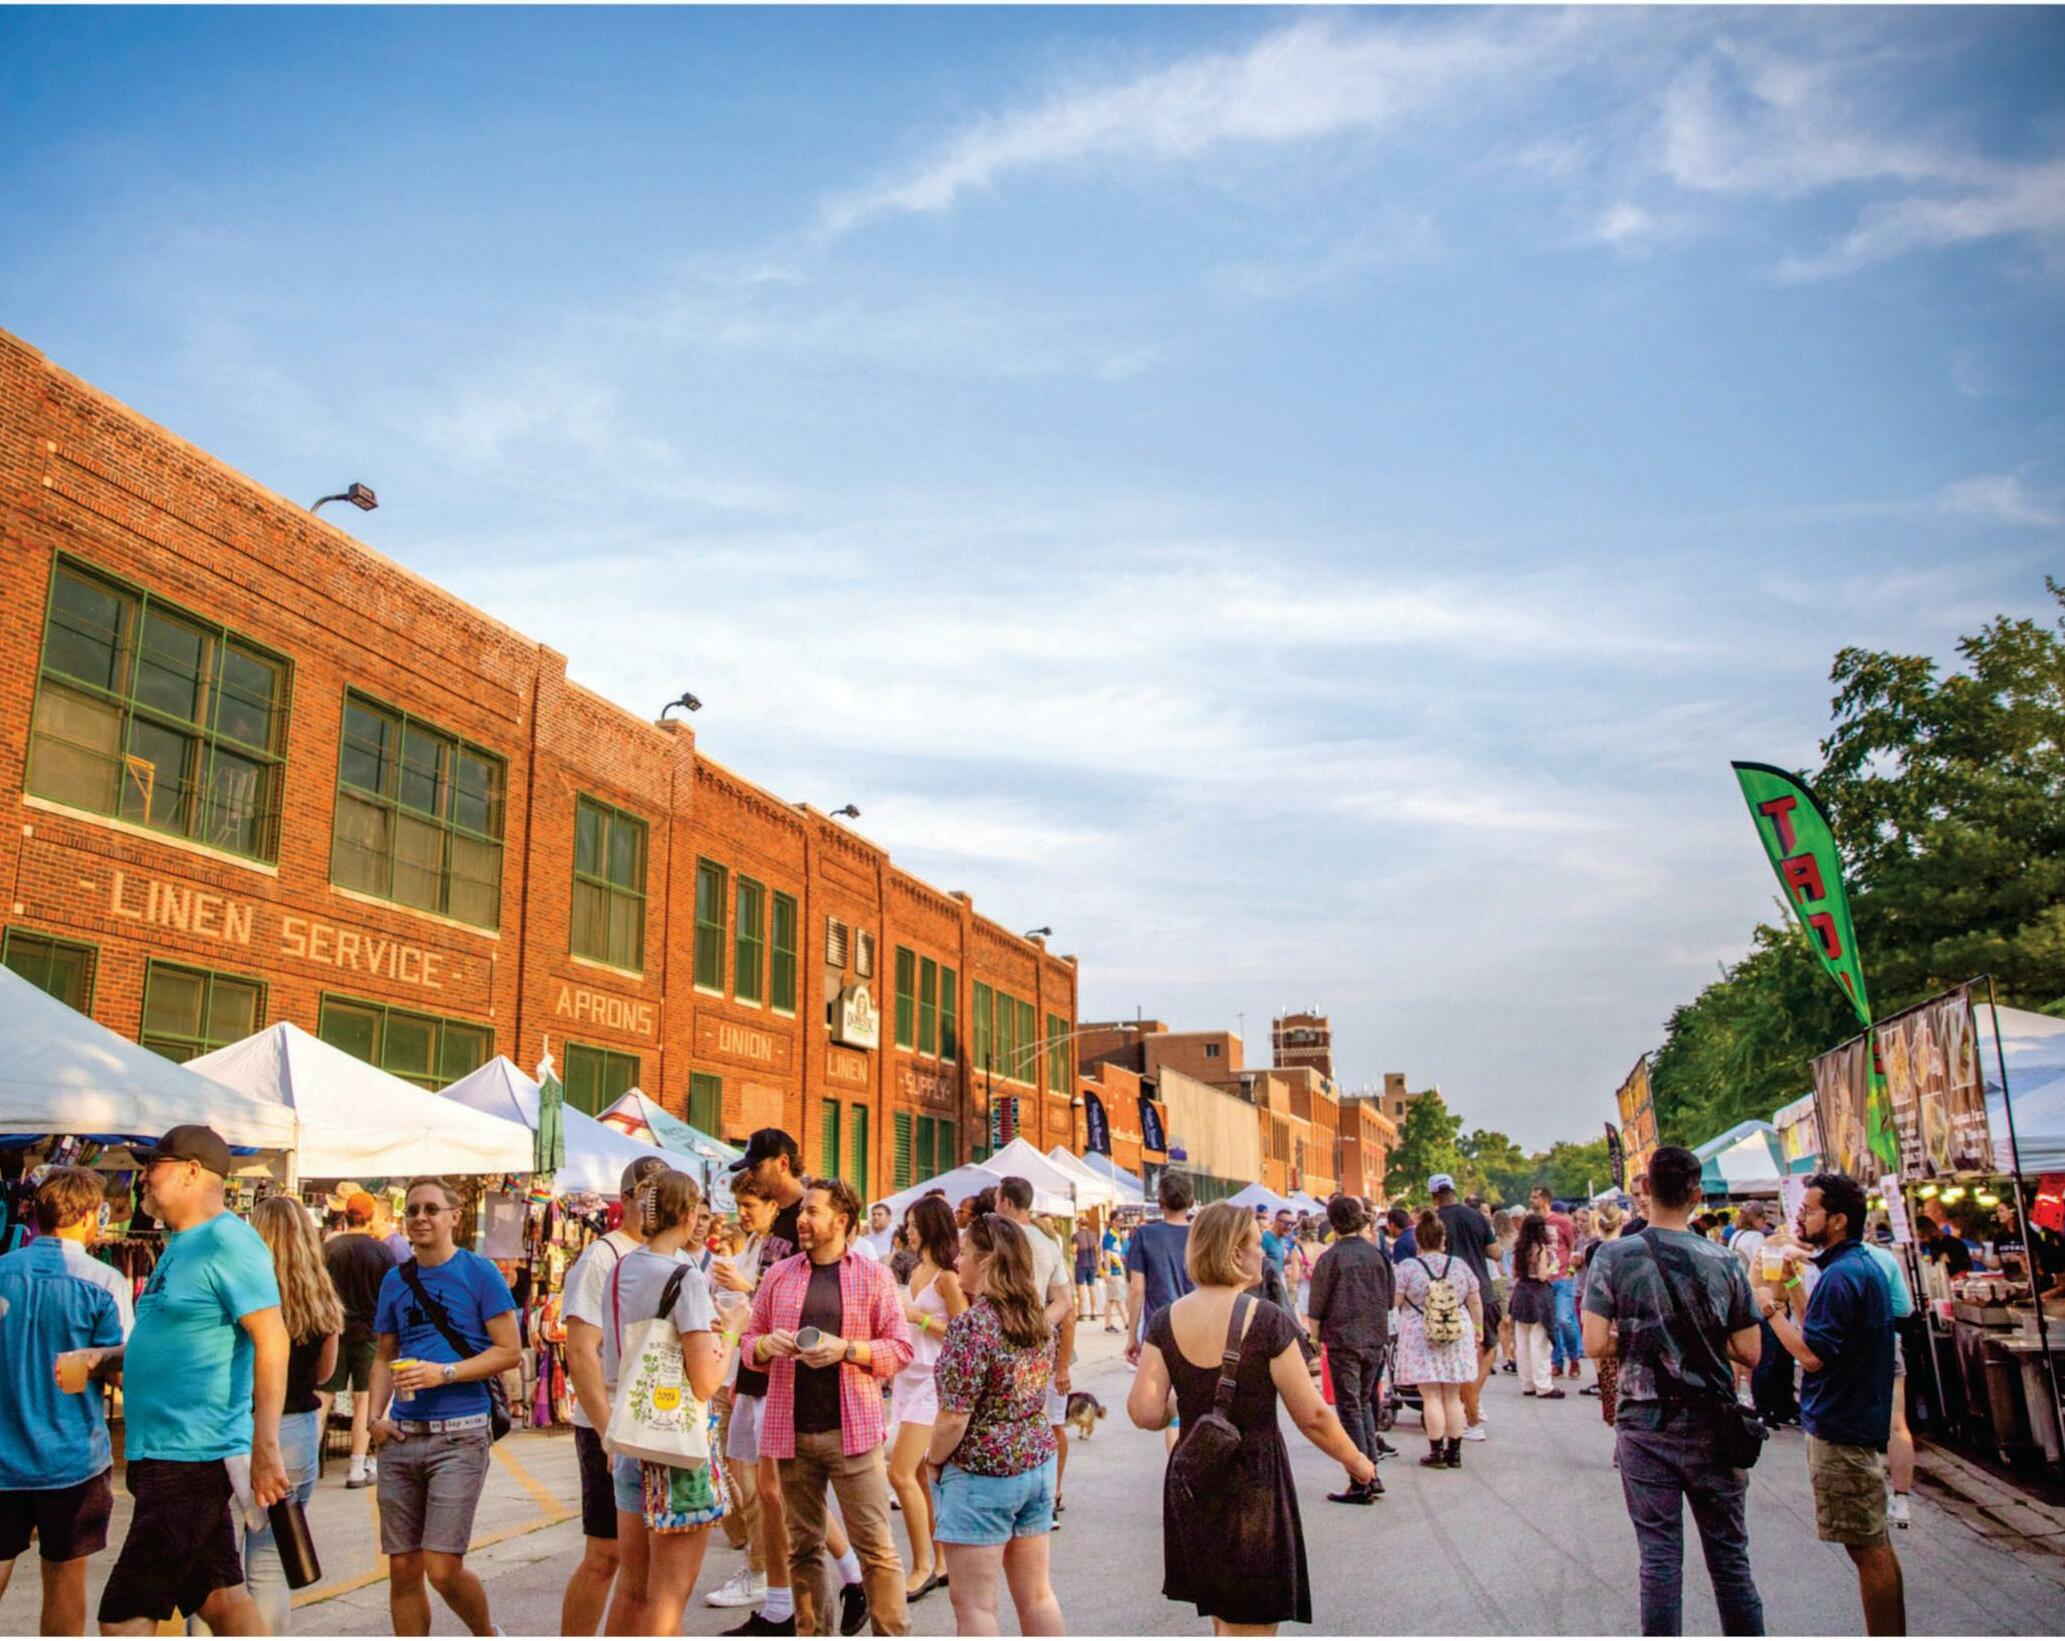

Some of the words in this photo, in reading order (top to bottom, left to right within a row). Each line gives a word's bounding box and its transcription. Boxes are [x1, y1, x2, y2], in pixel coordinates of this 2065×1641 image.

[112, 872, 252, 945] LINEN
[281, 916, 443, 988] SERVICE
[555, 986, 652, 1035] APRONS
[719, 1025, 772, 1061] UNION
[827, 1052, 867, 1083] LINEN
